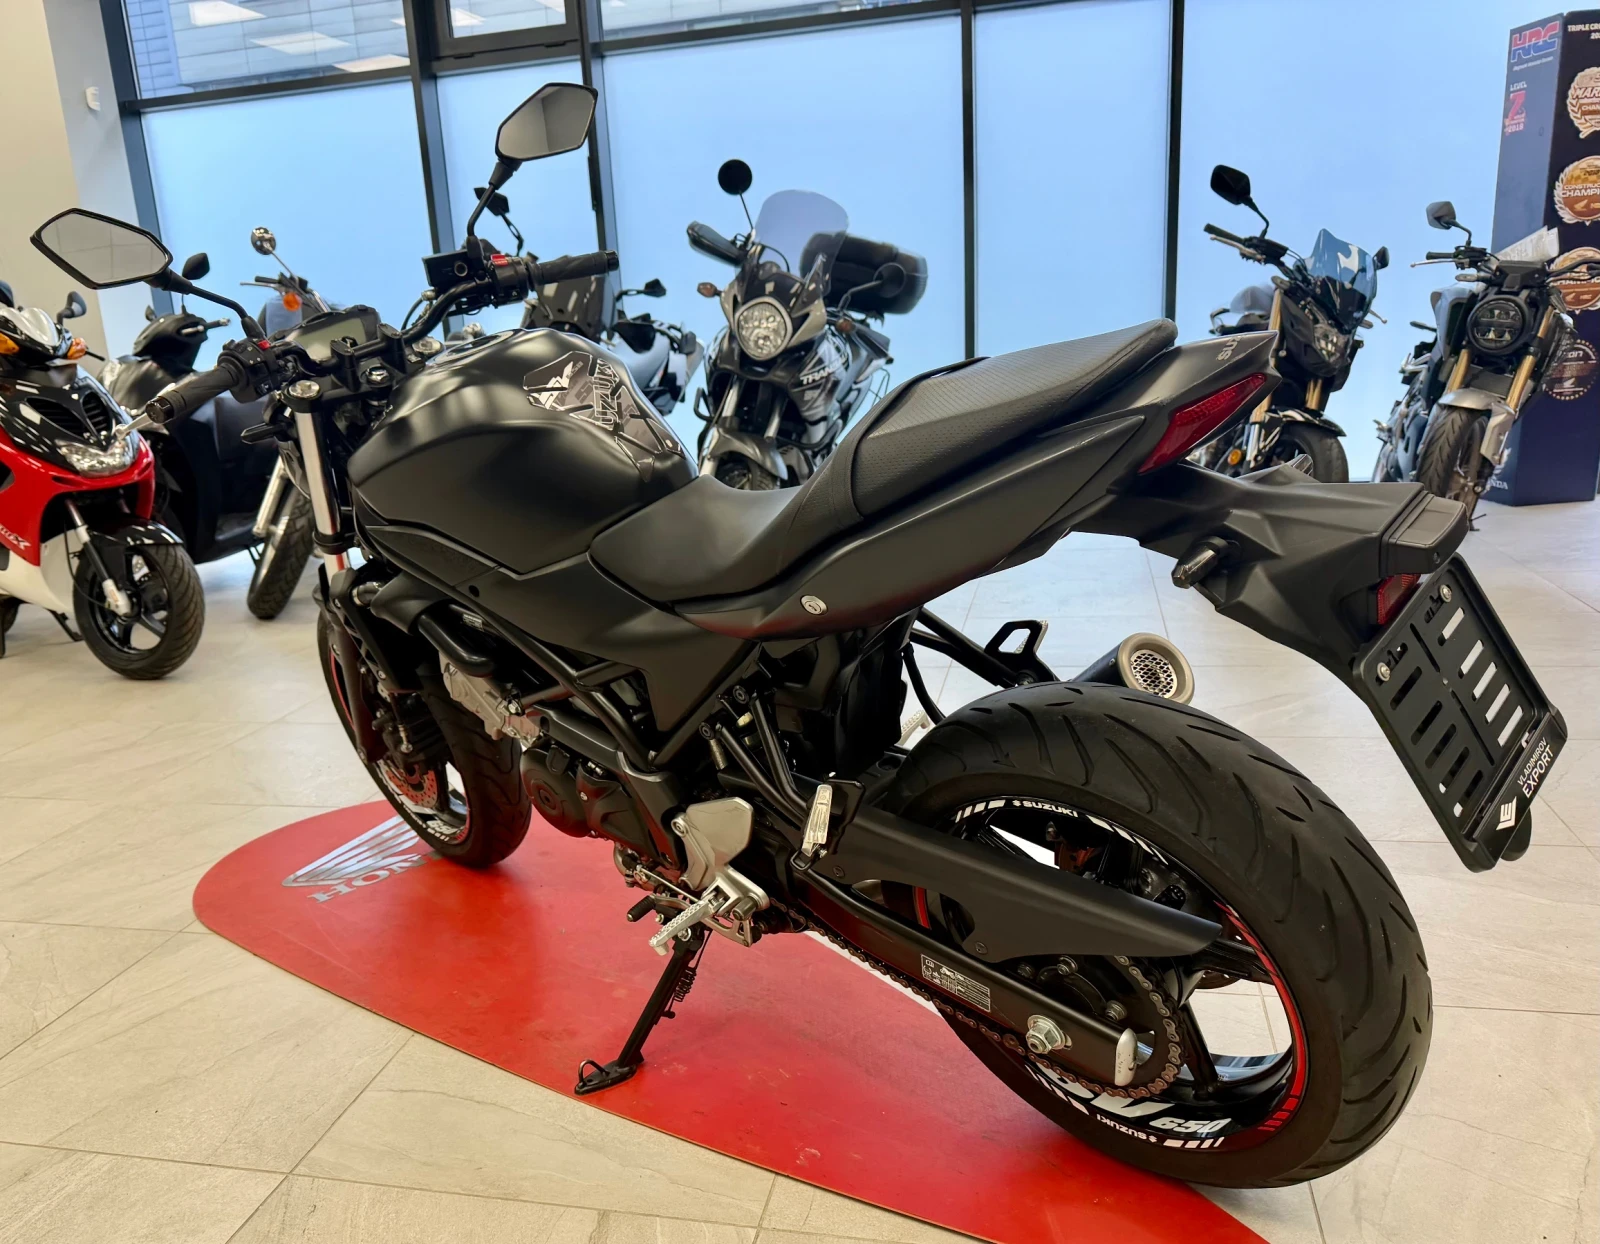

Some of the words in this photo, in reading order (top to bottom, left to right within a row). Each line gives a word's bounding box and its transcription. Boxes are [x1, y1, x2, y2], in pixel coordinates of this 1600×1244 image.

[1510, 20, 1560, 63] HRC
[1510, 81, 1527, 91] LEVEL
[1517, 737, 1548, 786] VLADIMIROV
[1522, 744, 1555, 799] EXPORT
[1023, 800, 1079, 818] SUZUKI
[1096, 1113, 1147, 1141] SUZUKI
[1149, 1116, 1233, 1134] 650
